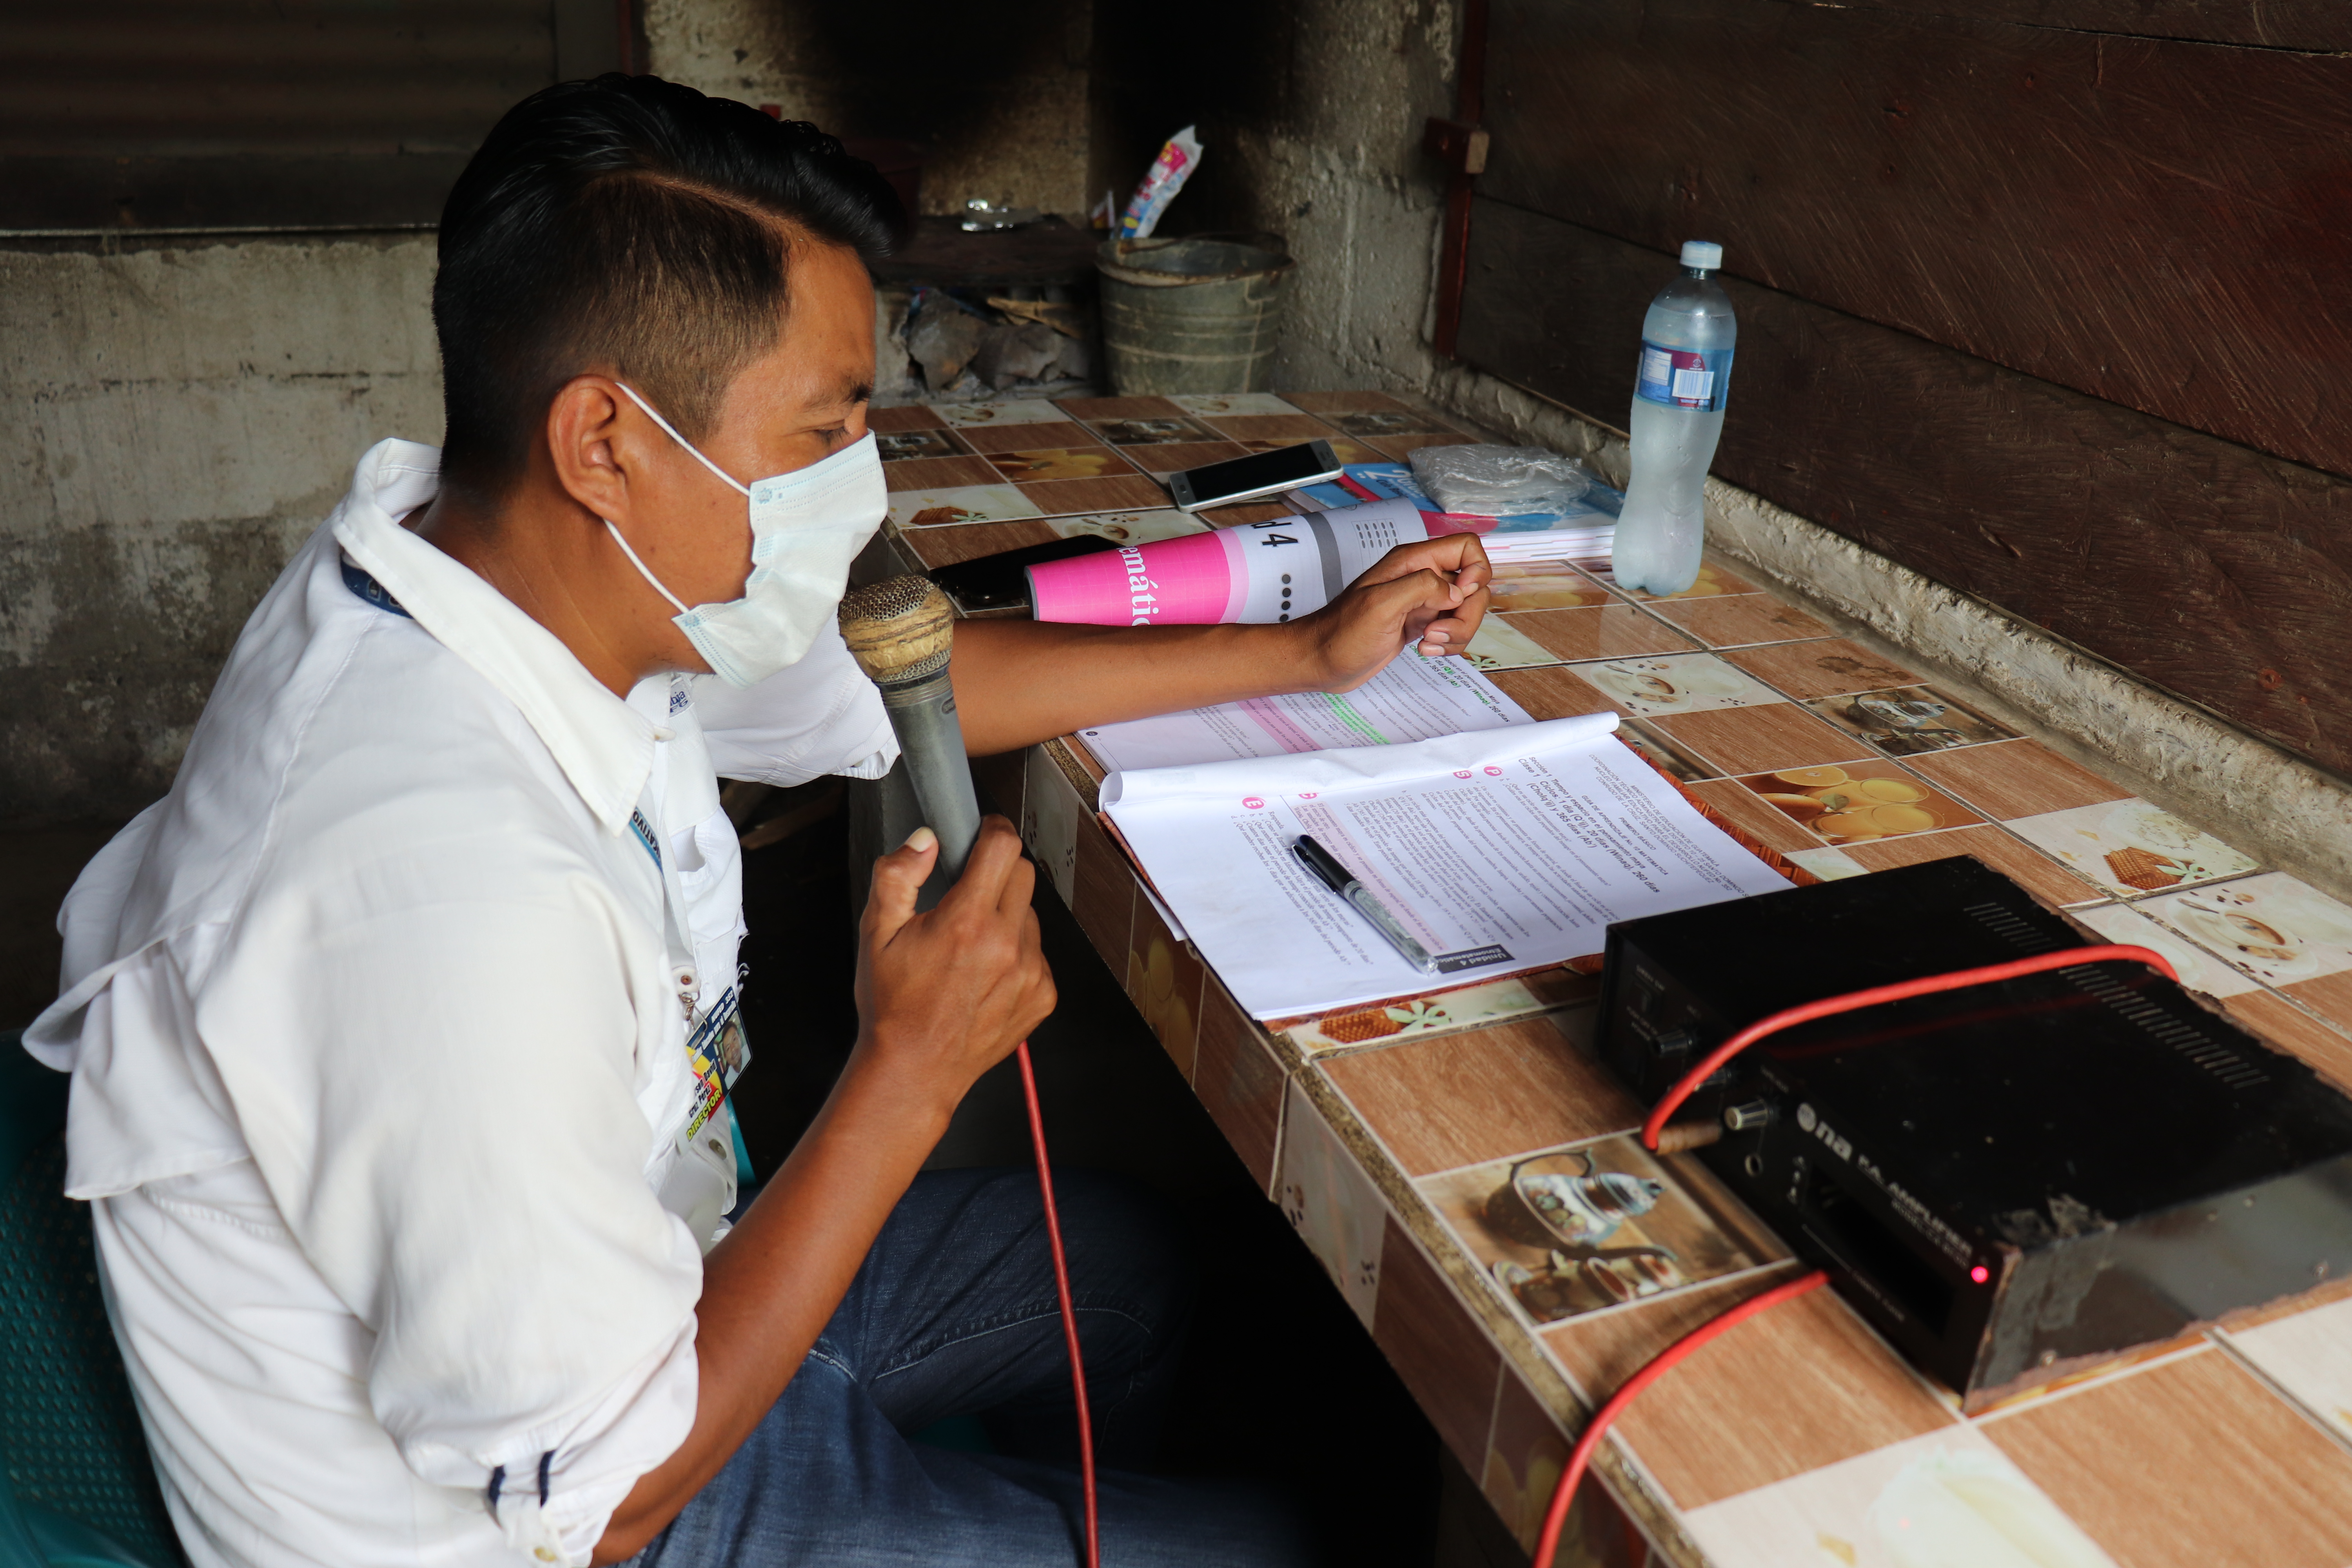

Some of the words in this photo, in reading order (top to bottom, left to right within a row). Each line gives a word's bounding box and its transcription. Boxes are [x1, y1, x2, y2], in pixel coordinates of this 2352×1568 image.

[1262, 534, 1298, 547] 4
[1442, 656, 1457, 667] espacio
[1463, 675, 1489, 695] pensamiento
[1488, 695, 1500, 704] Maya
[1460, 680, 1472, 688] días
[1497, 713, 1510, 722] días
[1518, 759, 1534, 773] Clase
[1540, 781, 1560, 799] Ciclos:
[1562, 804, 1573, 813] día
[1595, 837, 1609, 848] días
[1632, 871, 1648, 880] 260
[1644, 881, 1660, 893] días
[1529, 757, 1548, 773] Sección
[1551, 779, 1568, 795] Tiempo
[1570, 799, 1590, 816] espacio
[1597, 829, 1631, 856] pensamiento
[1630, 857, 1646, 869] maya
[1556, 812, 1571, 822] 365
[1566, 823, 1581, 834] días
[1581, 795, 1593, 805] GUIA
[1597, 812, 1627, 838] APRENDIZAJE
[1638, 851, 1668, 875] MATEMATICA
[1589, 754, 1620, 781] COORDINACIÓN
[1618, 781, 1638, 799] TÉCNICO
[1635, 799, 1670, 832] ADMINISTRATIVA
[1668, 832, 1690, 849] DISTRITO
[1703, 862, 1721, 875] SANTO
[1719, 875, 1744, 893] DOMINGO
[1596, 776, 1617, 795] CONRADO
[1626, 808, 1641, 820] CRUZ,
[1639, 821, 1656, 835] SANTO
[1653, 835, 1677, 853] DOMINGO
[1675, 853, 1714, 883] SUCHITEPÉQUEZ
[1609, 782, 1630, 799] FAMILIAR
[1627, 799, 1653, 824] EDUCATIVO
[1650, 824, 1664, 835] PARA
[1668, 840, 1699, 864] DESARROLLO
[1697, 865, 1715, 877] NUFED
[1618, 817, 1639, 835] PRIMERO
[1637, 836, 1656, 850] BÁSICO
[1630, 785, 1655, 809] MINISTERIO
[1659, 816, 1686, 838] EDUCACIÓN
[1691, 844, 1719, 867] GUATEMALA
[711, 1002, 725, 1024] NUFED
[725, 990, 734, 1004] 352
[703, 1061, 717, 1082] David
[686, 1088, 721, 1142] DIRECTOR
[1887, 1181, 1973, 1259] AMPLIFIER
